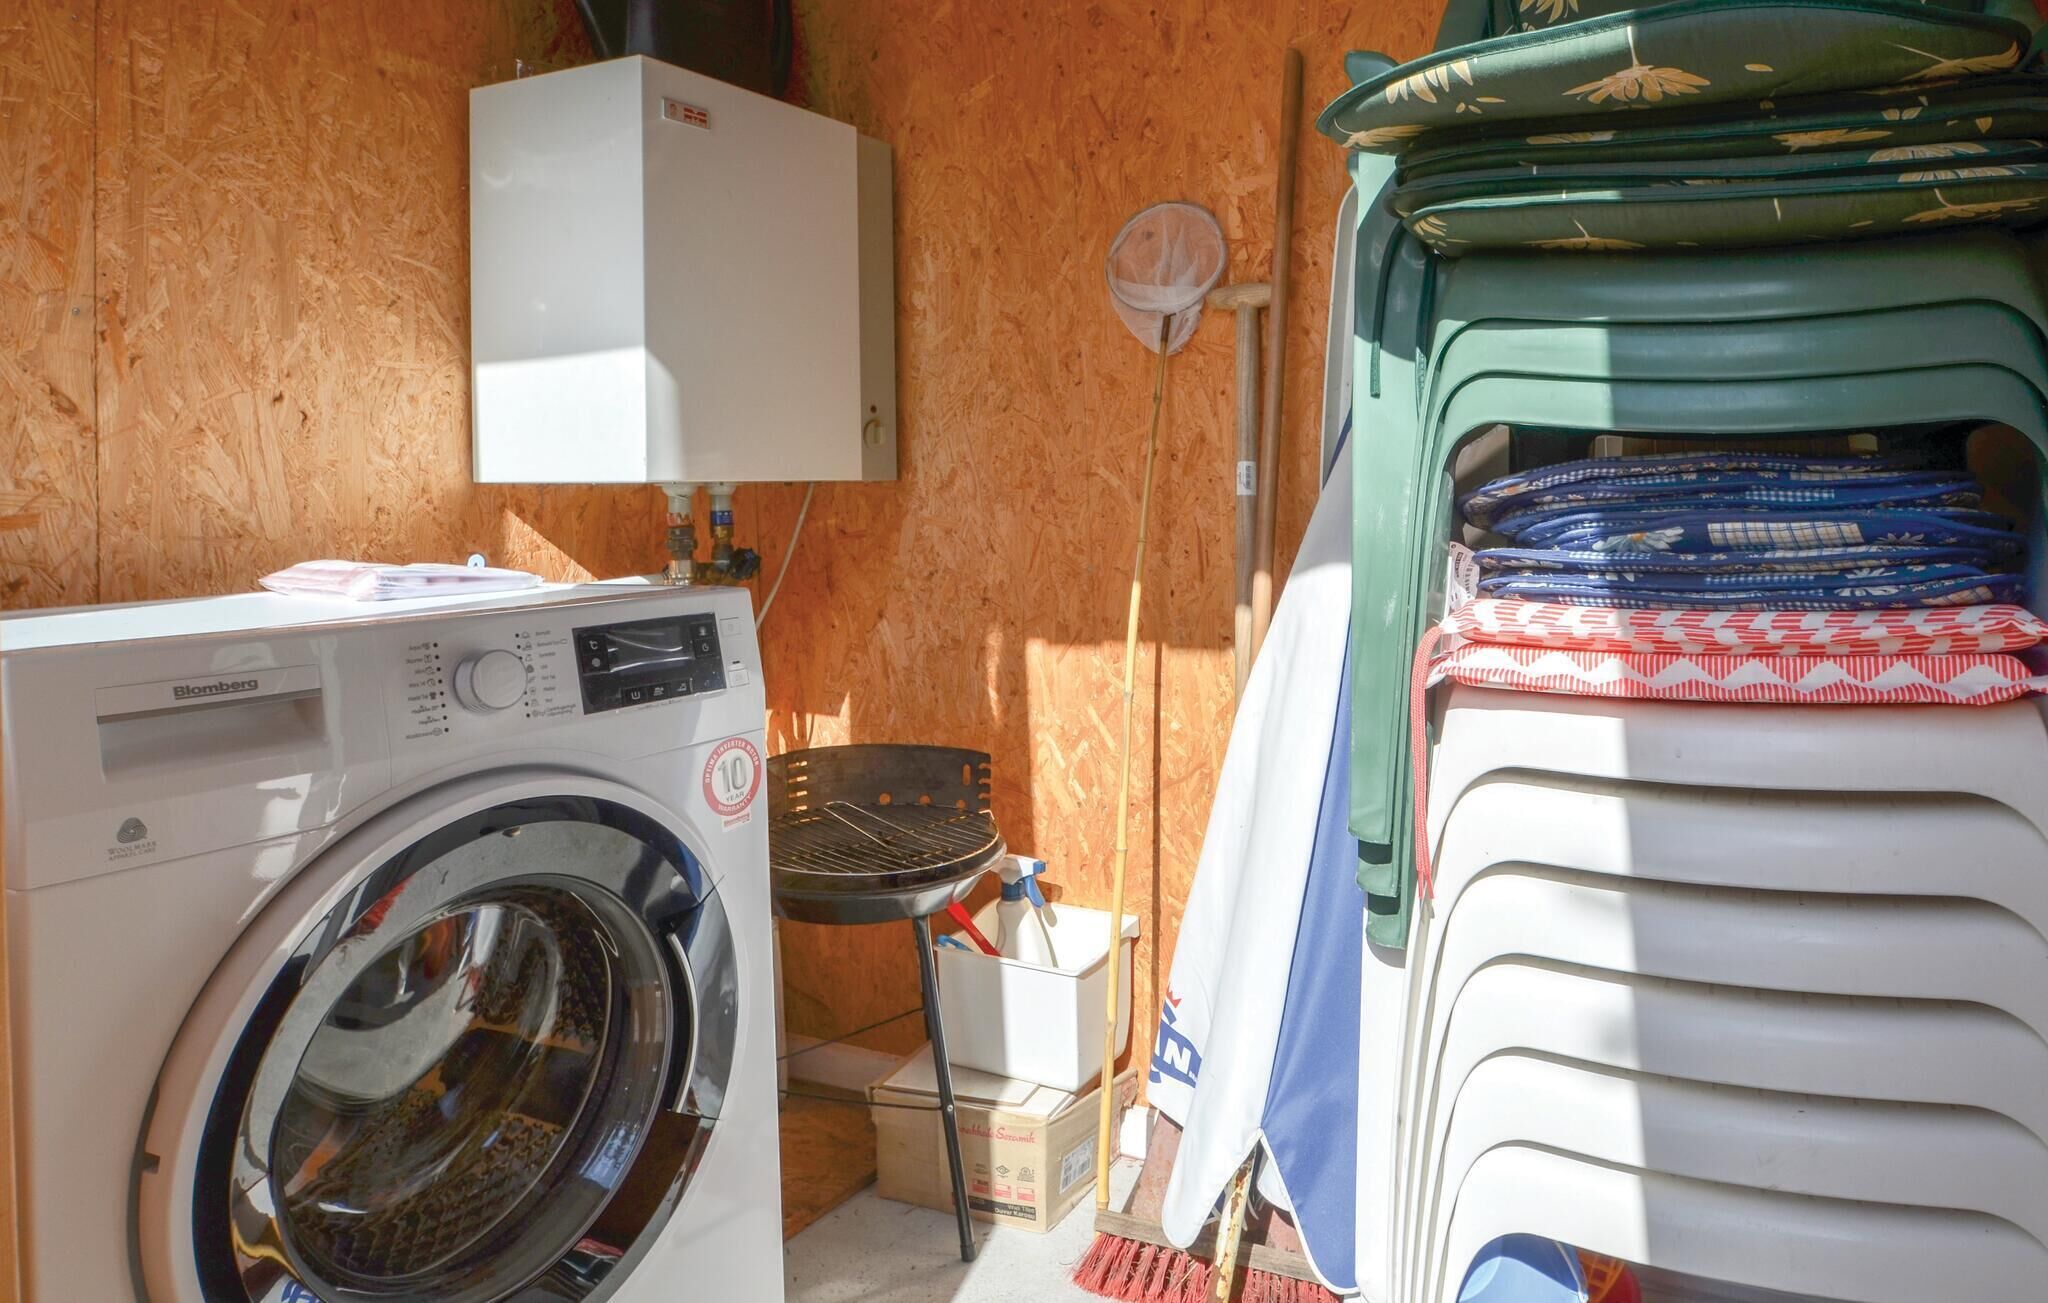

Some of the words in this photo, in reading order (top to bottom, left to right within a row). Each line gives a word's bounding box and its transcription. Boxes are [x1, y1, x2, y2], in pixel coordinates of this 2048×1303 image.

[173, 680, 259, 699] Blomberg
[718, 756, 748, 793] 10
[718, 792, 752, 812] WARRANTY
[726, 791, 745, 802] YEAR
